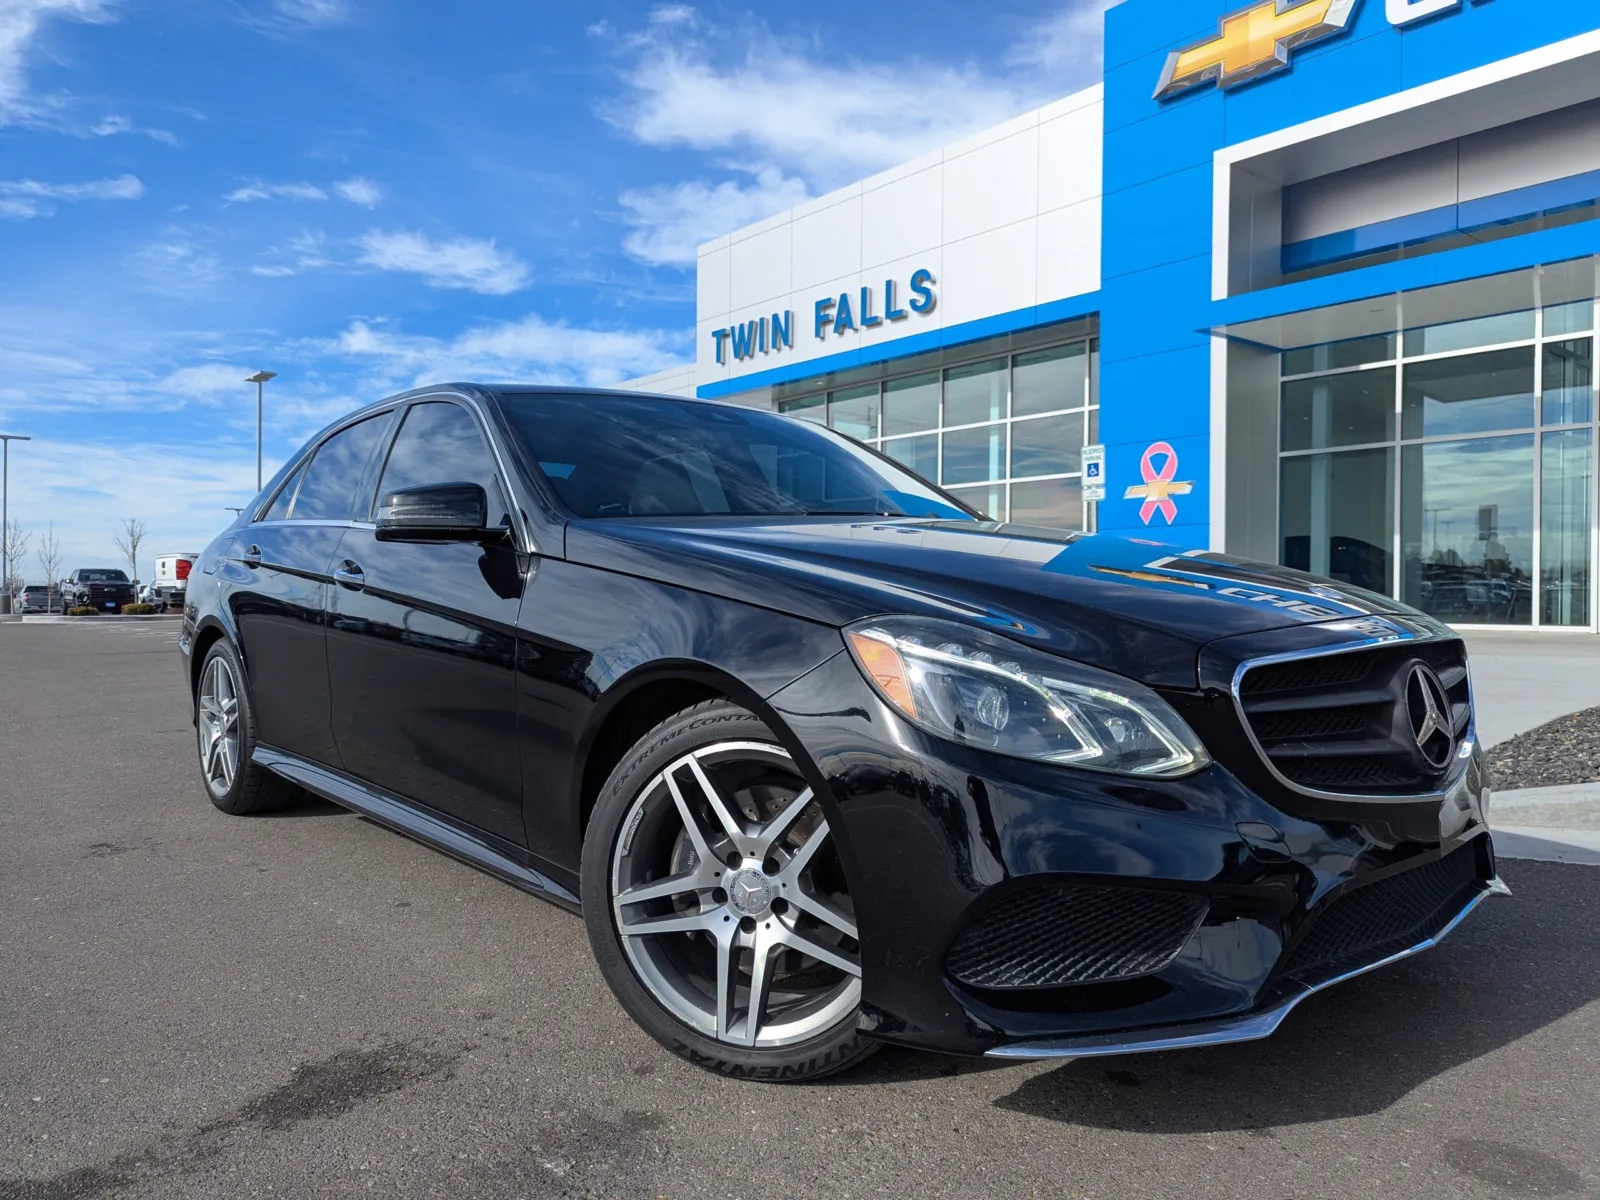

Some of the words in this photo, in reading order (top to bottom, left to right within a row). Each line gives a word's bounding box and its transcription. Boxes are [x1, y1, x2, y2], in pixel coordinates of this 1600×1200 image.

[712, 310, 793, 365] TWIN
[814, 269, 936, 341] FALLS
[613, 714, 761, 797] EXTREMECONTA
[671, 1036, 861, 1079] NTINENTAL
